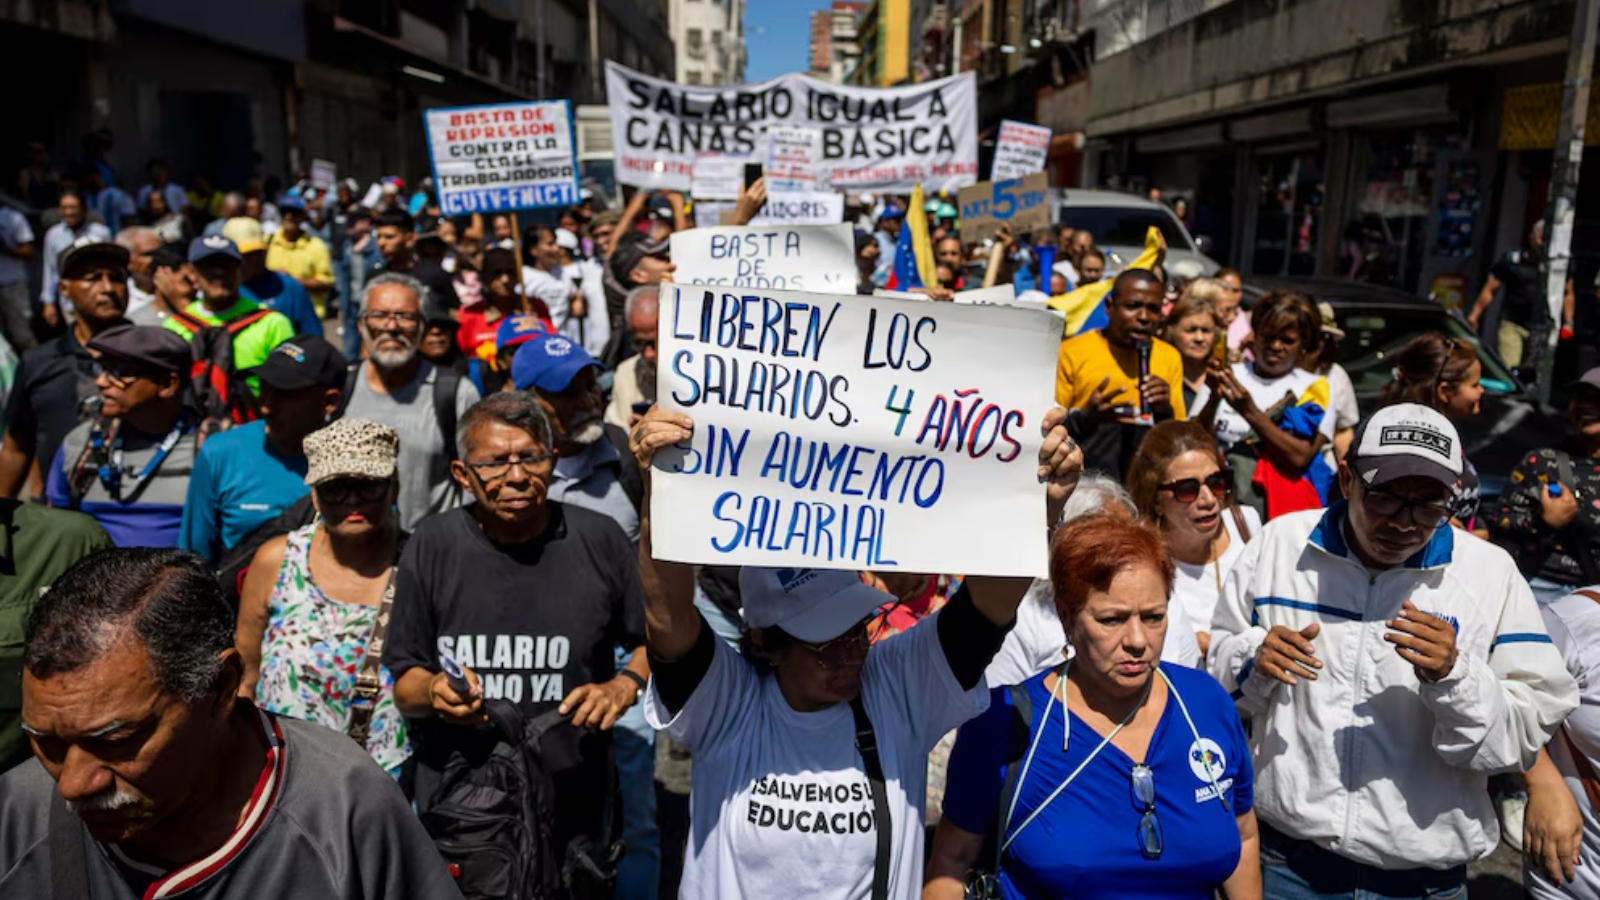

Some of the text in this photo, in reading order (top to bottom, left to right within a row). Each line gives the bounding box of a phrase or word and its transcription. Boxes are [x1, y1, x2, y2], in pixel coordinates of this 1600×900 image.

[450, 107, 544, 127] BASTA DE
[628, 82, 947, 122] SALARIO IGUAL A
[446, 123, 555, 142] REPRESION
[450, 137, 557, 157] CONTRA LA
[626, 118, 768, 154] CANAS
[822, 124, 956, 160] BASICA
[441, 166, 572, 188] TRABAJADORA
[475, 154, 534, 170] CLASE
[711, 231, 801, 259] BASTA
[737, 258, 765, 278] DE
[673, 288, 936, 372] LIBEREN LOS
[671, 349, 1024, 463] SALARIOS. 4 AÑOS
[673, 424, 945, 509] SIN AUMENTO
[710, 491, 898, 567] SALARIAL
[437, 635, 570, 670] SALARIO
[530, 673, 564, 703] YA
